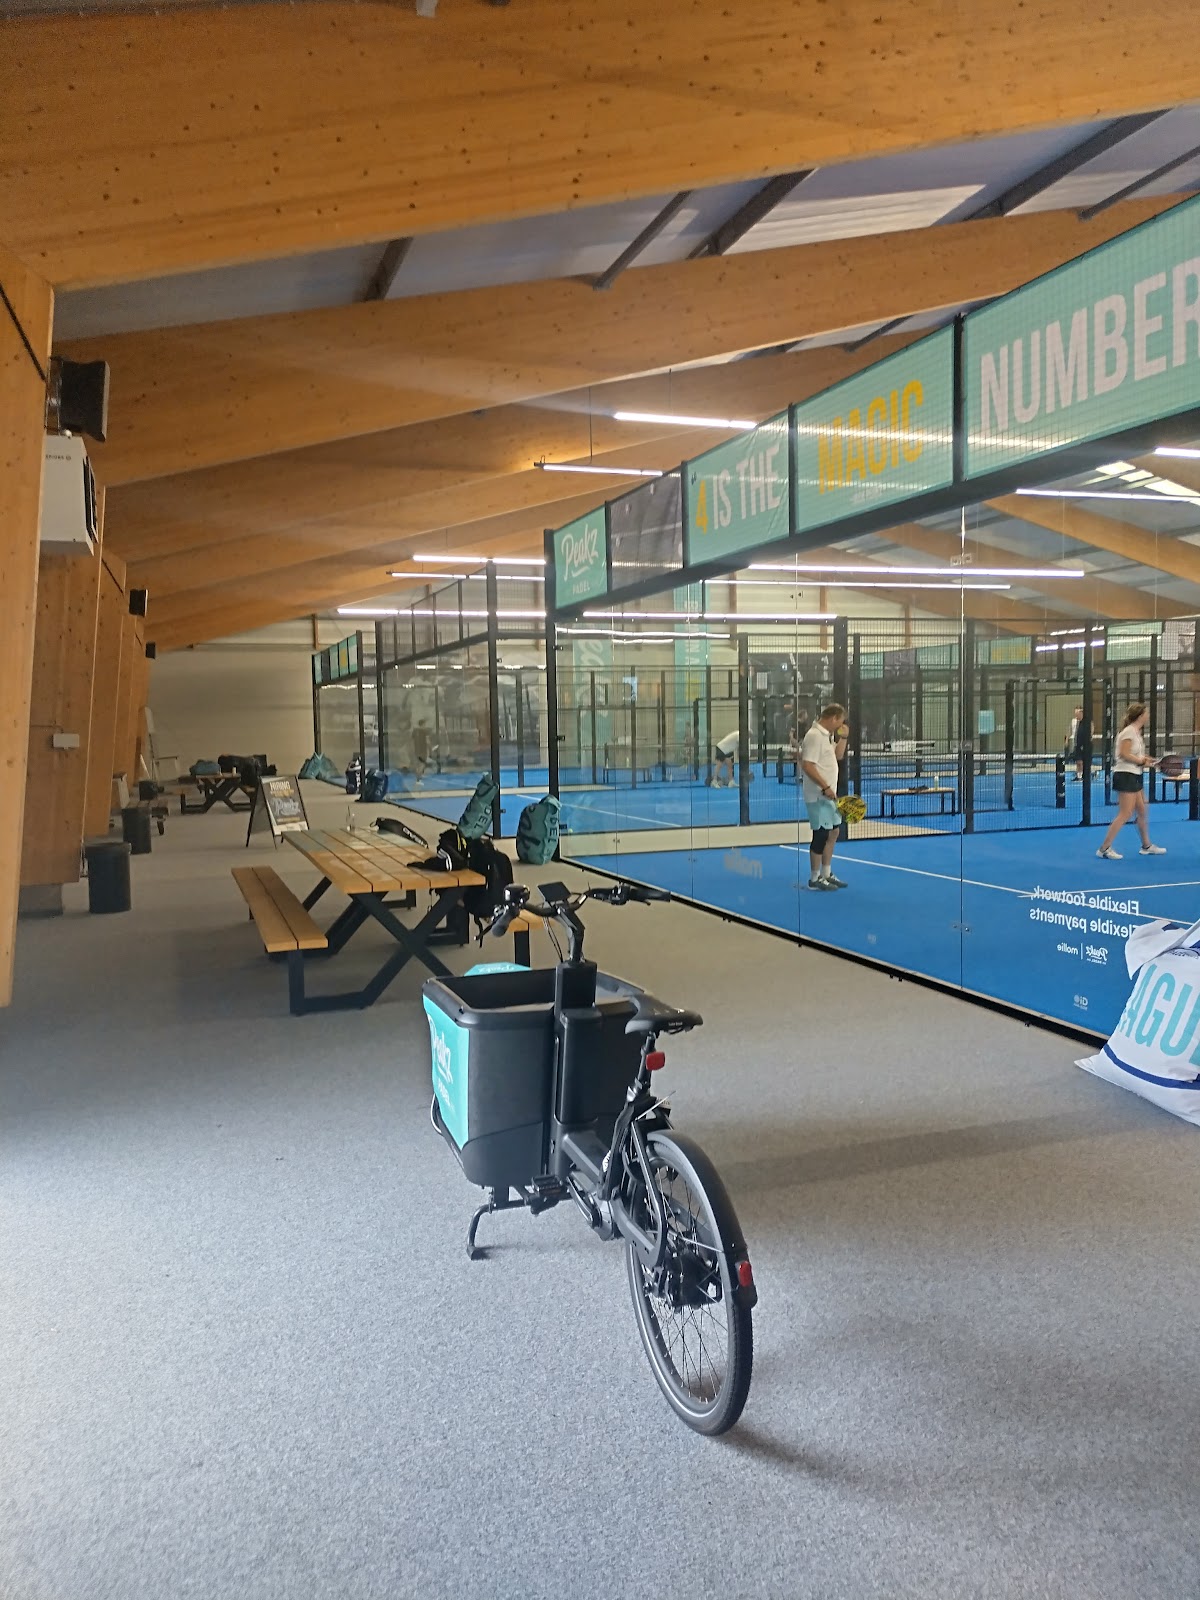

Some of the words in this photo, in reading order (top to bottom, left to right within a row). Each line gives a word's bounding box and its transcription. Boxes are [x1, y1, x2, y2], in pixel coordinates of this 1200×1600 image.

[696, 480, 708, 534] 4
[713, 468, 732, 530] IS
[736, 446, 781, 520] THE
[819, 380, 924, 495] MAGIC
